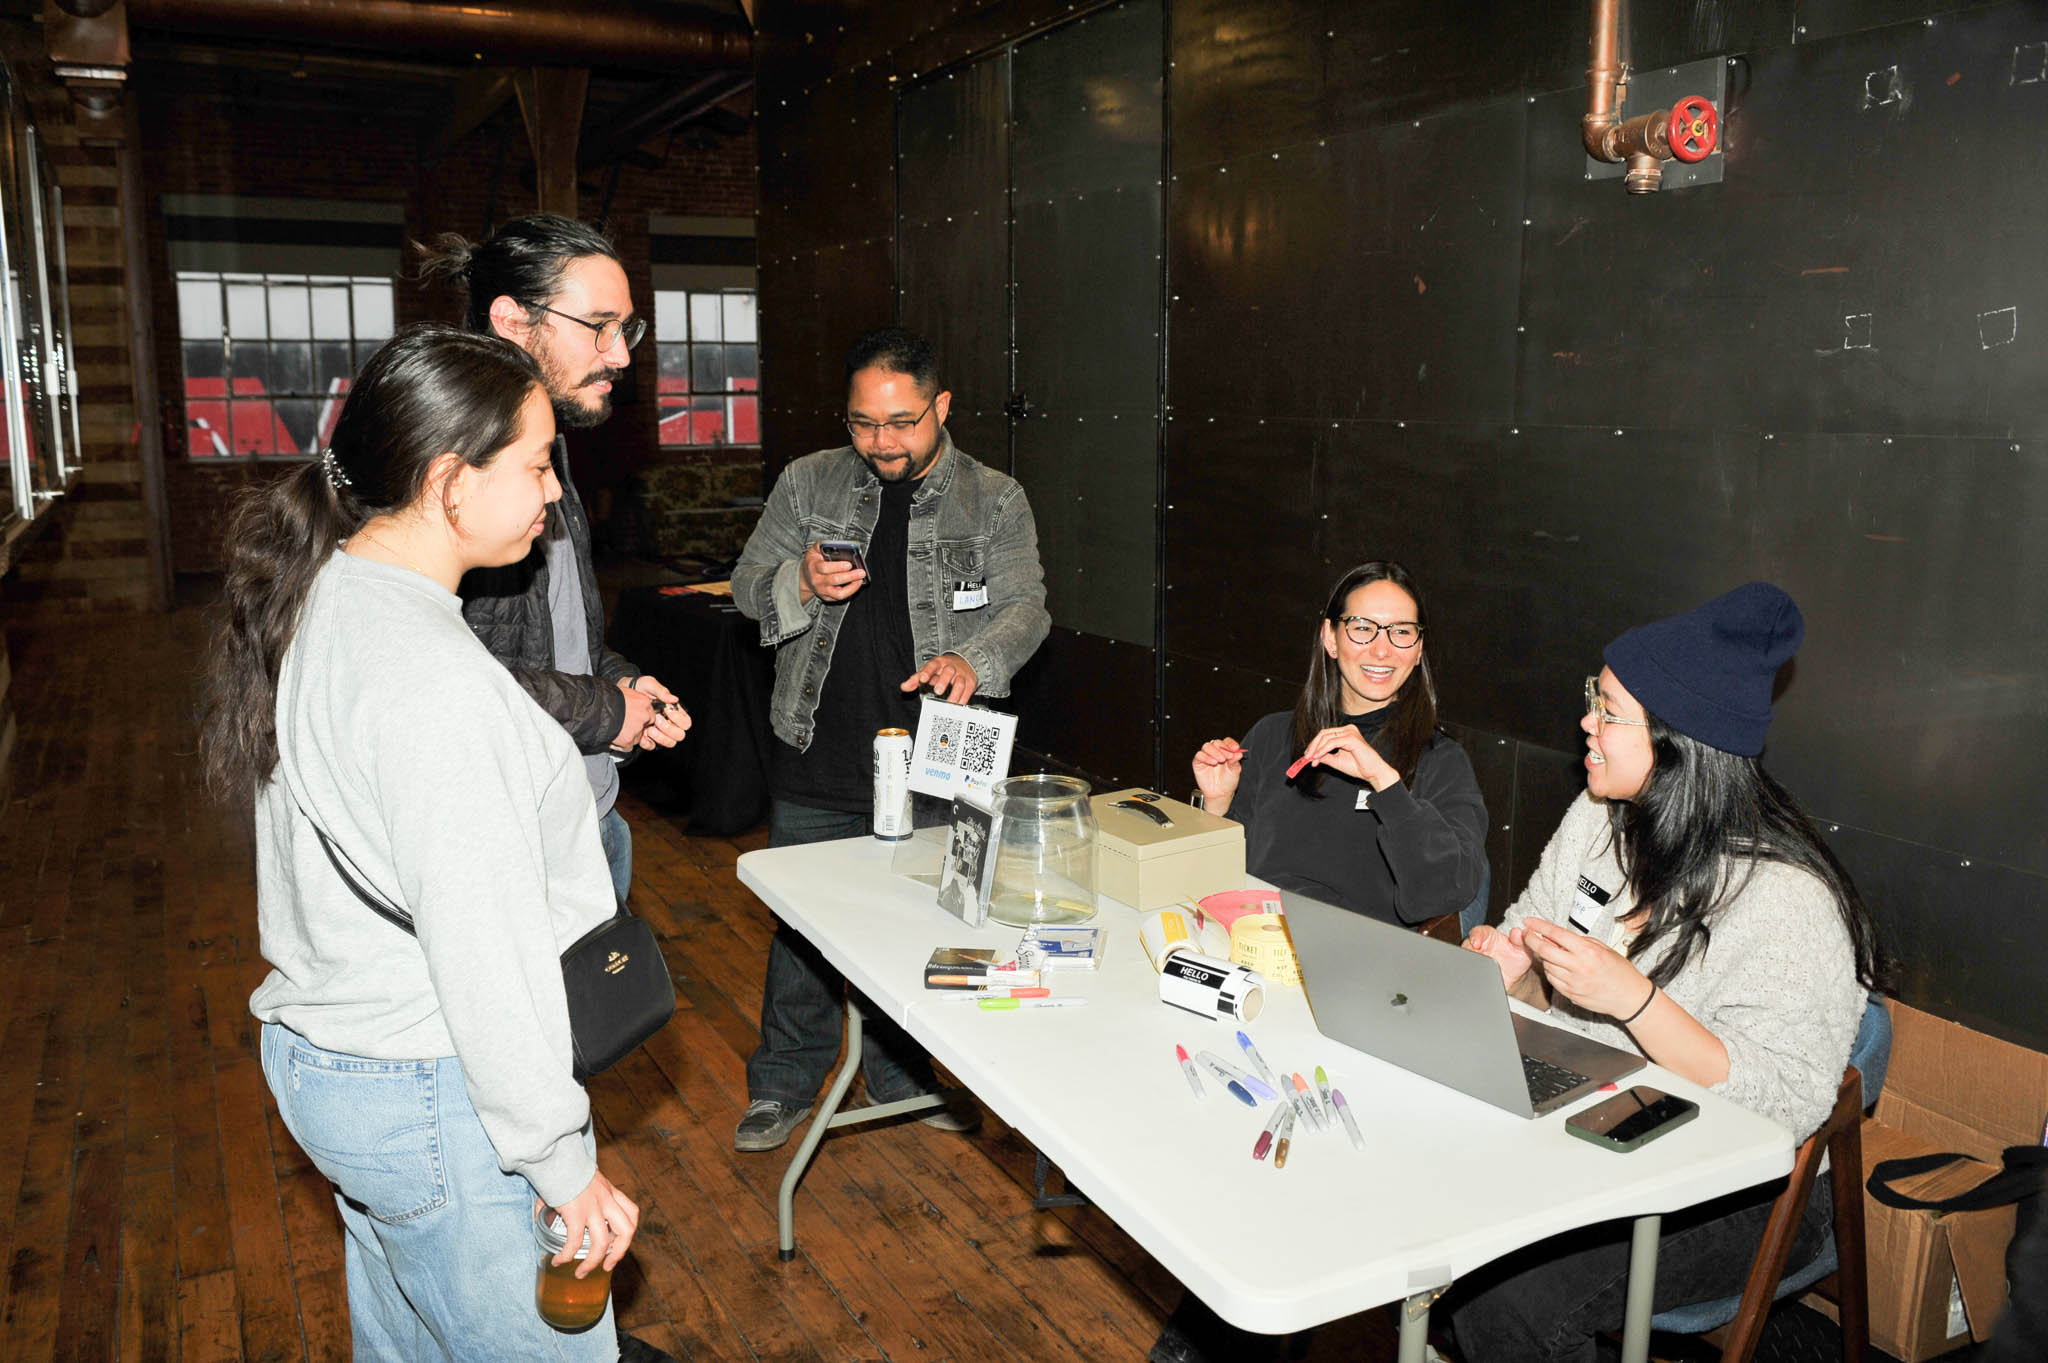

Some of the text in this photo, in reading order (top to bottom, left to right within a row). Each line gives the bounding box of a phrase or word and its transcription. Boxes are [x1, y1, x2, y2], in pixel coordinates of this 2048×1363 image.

[925, 767, 951, 781] venmo
[1239, 942, 1257, 954] TICKET
[1180, 966, 1209, 981] HELLO
